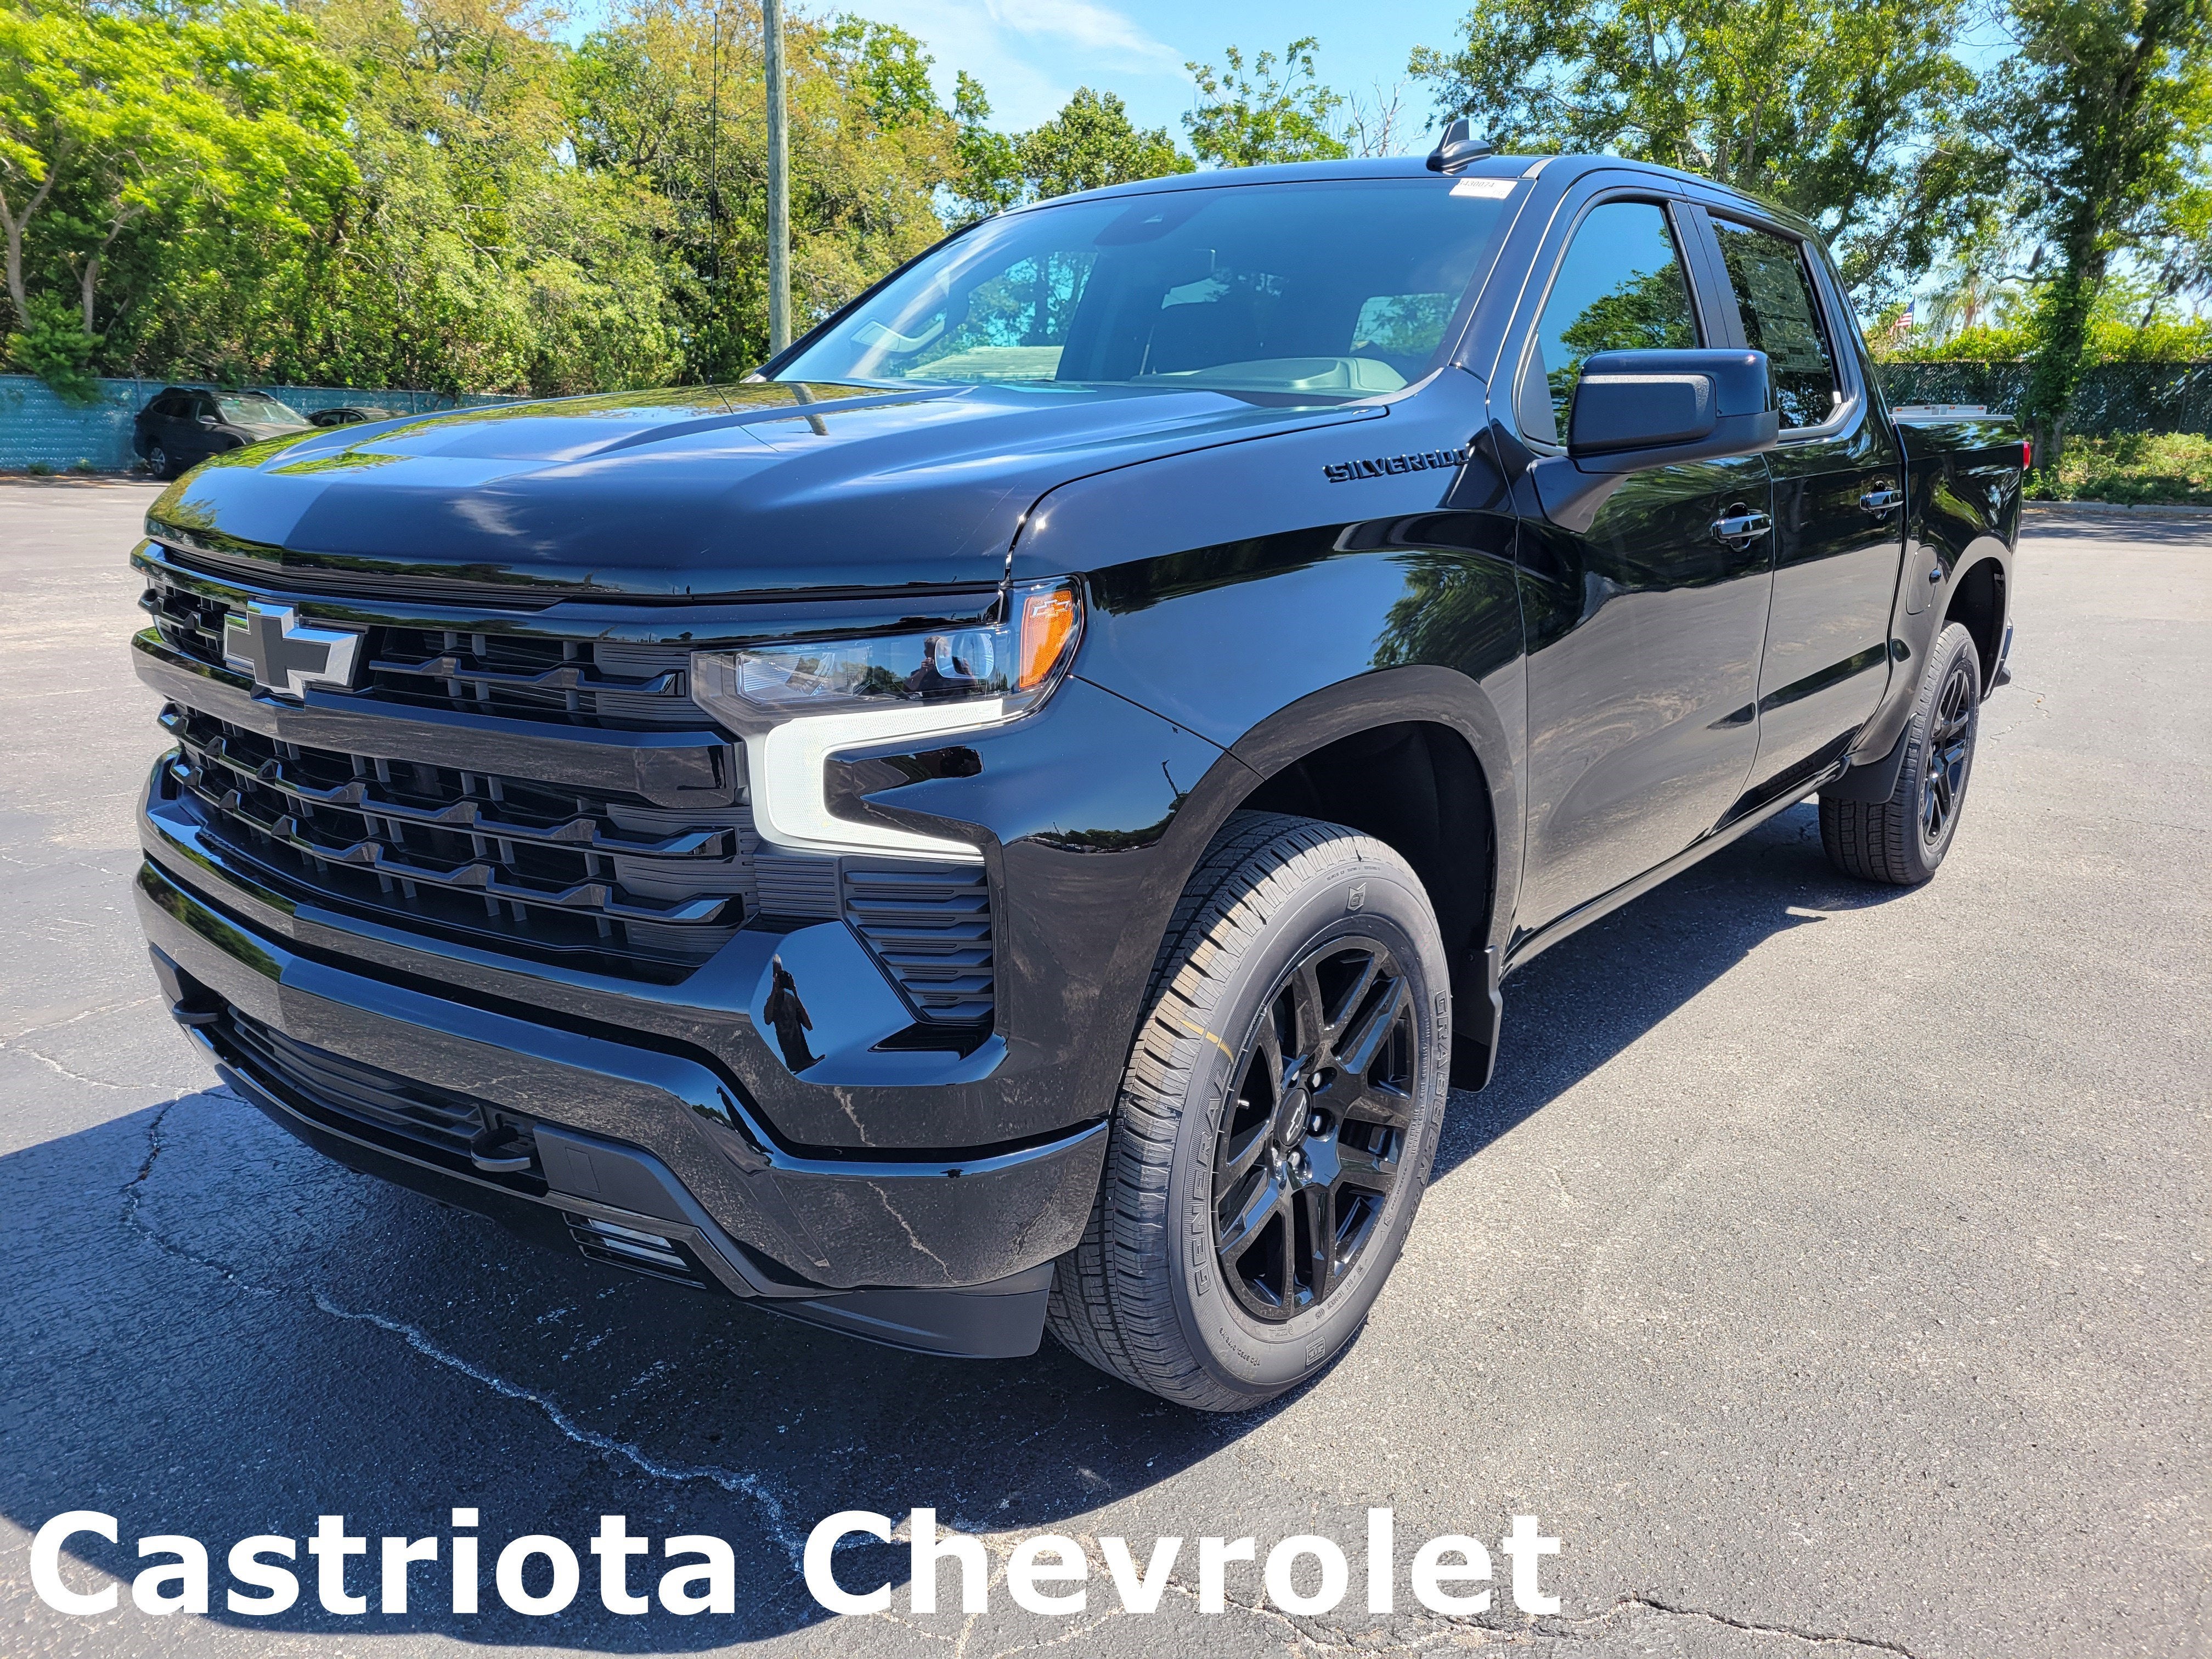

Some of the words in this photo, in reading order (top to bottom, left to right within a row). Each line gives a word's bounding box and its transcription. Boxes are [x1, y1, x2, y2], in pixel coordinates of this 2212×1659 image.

[1322, 444, 1471, 483] SILVERADO
[1190, 1063, 1231, 1296] GENERAL
[1416, 989, 1449, 1187] GRABBER
